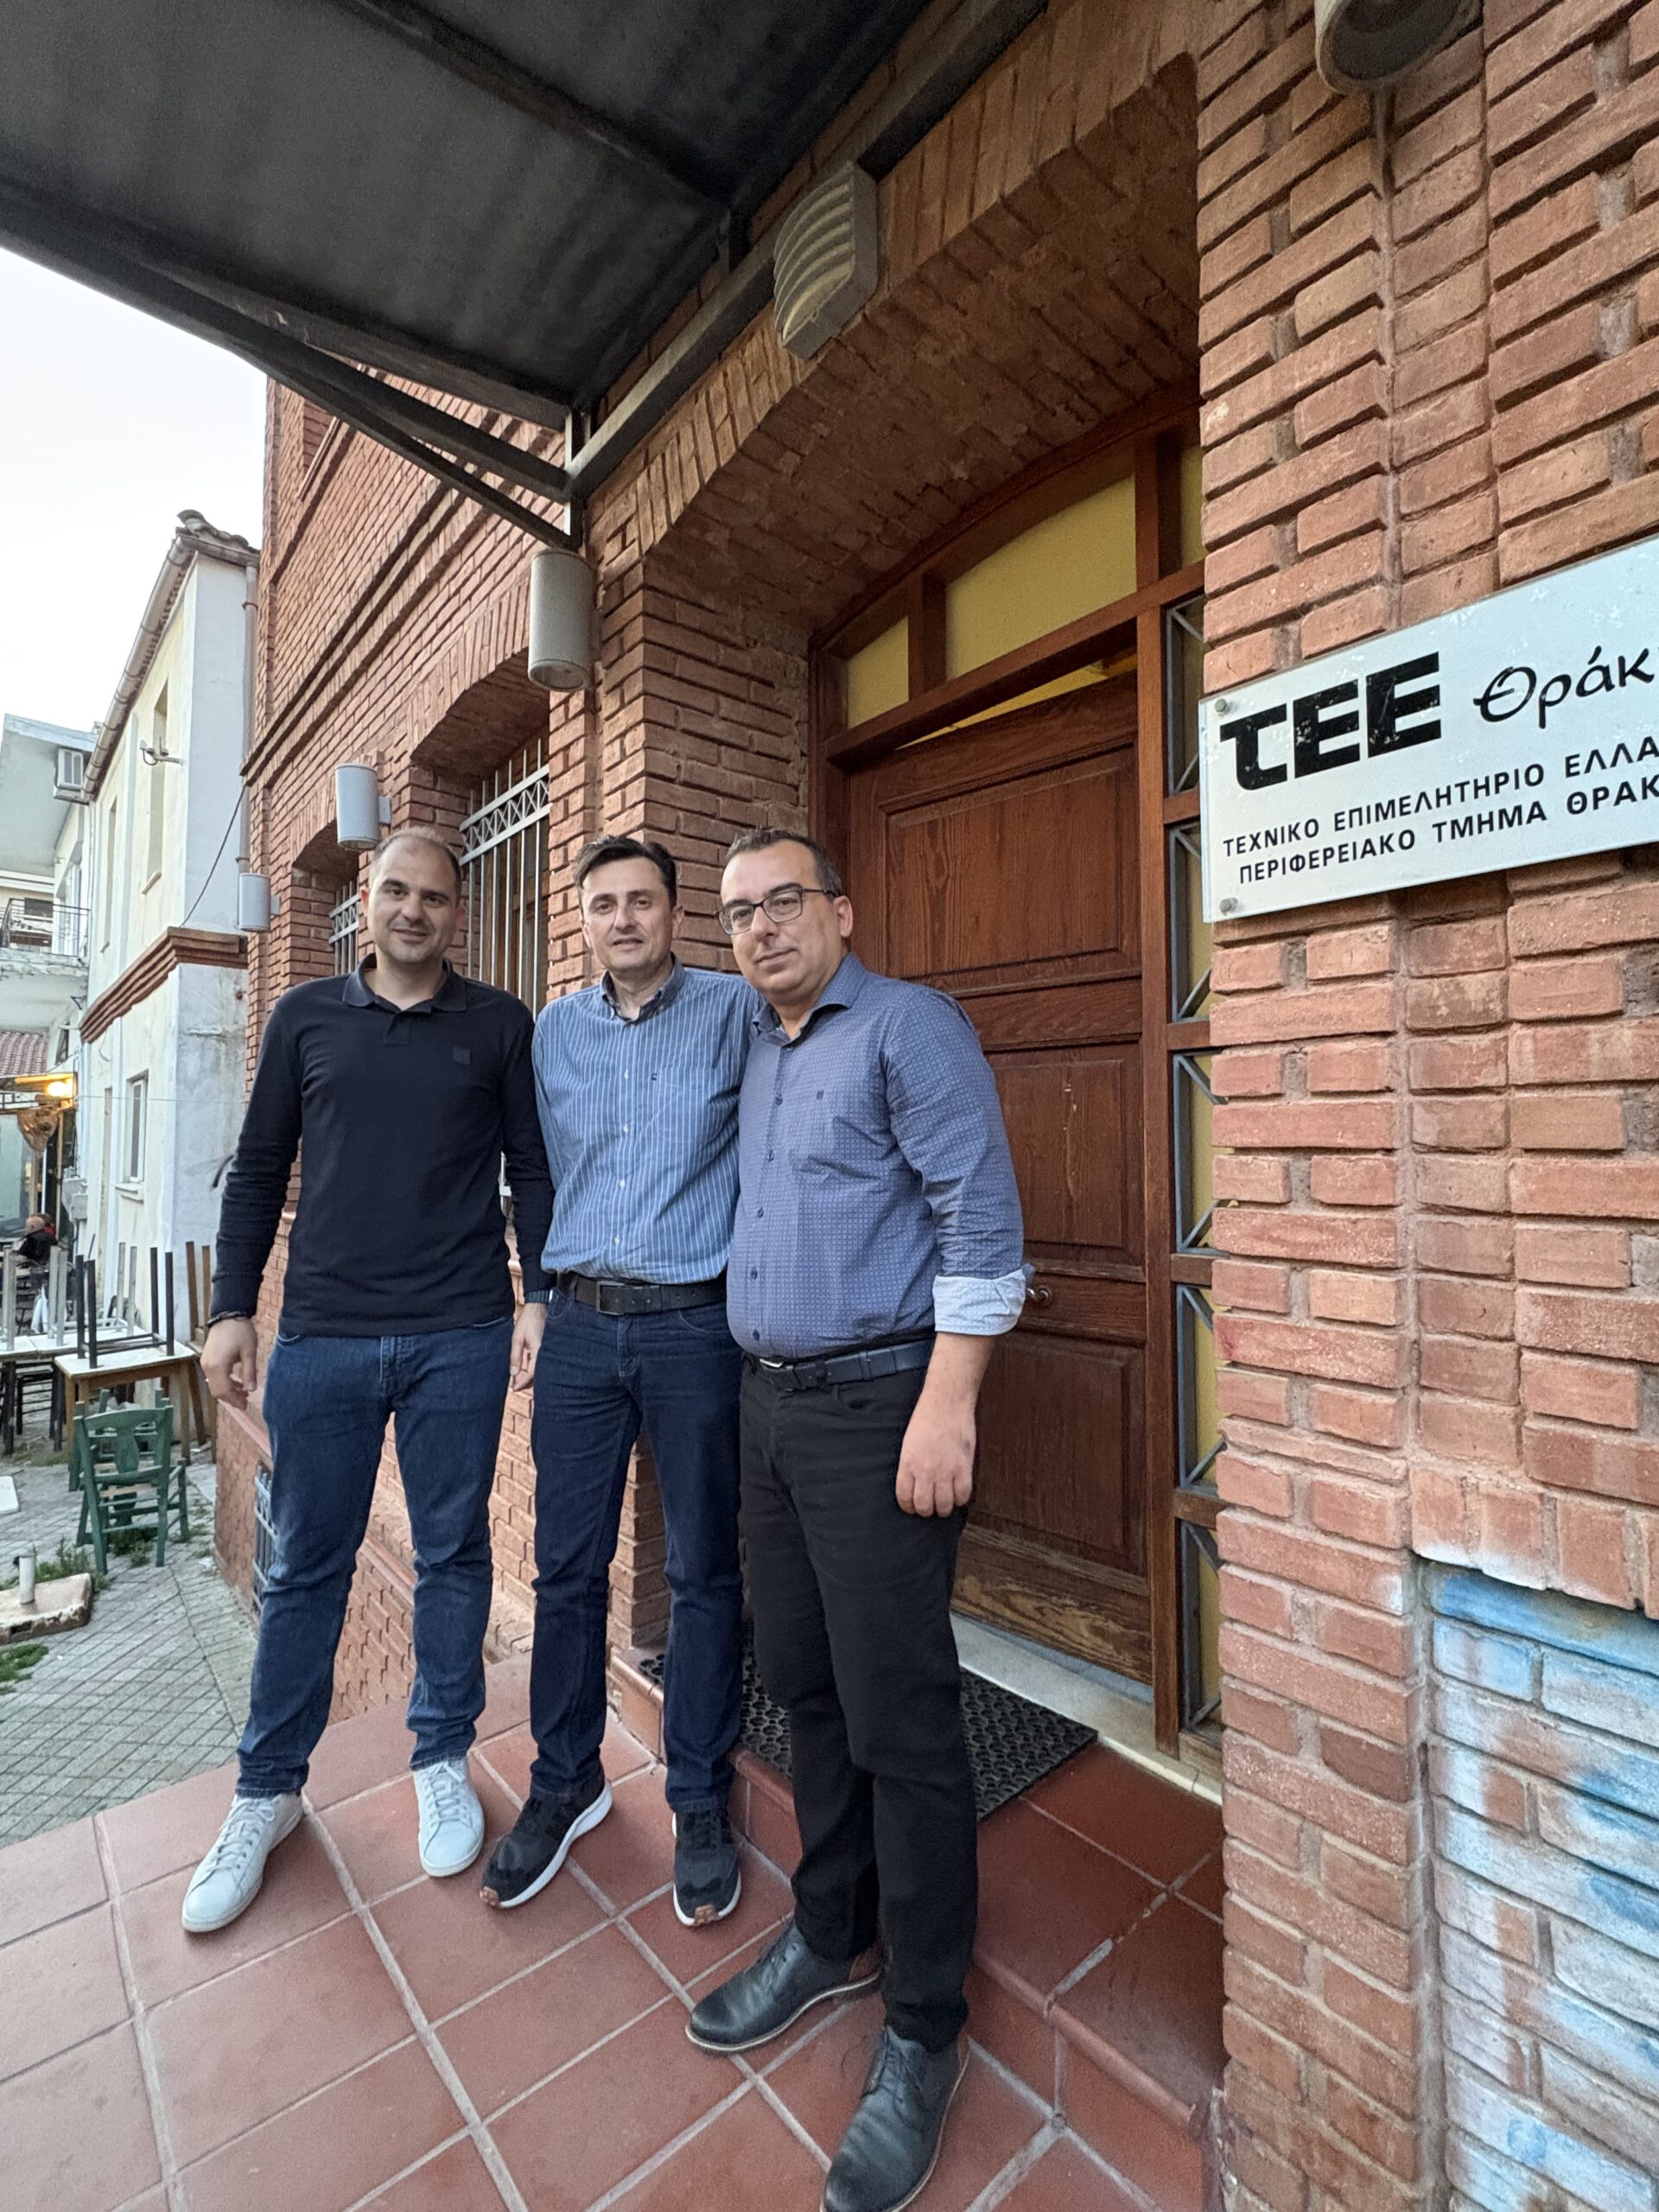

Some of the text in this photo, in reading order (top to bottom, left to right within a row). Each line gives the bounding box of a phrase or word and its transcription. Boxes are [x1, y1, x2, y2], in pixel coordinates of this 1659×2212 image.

[1473, 645, 1659, 728] Θράκ
[1224, 818, 1319, 857] ΤΕΧΝΙΚΟ
[1334, 763, 1545, 832] ΕΠΙΜΕΛΗΤΗΡΙΟ
[1240, 830, 1415, 883] ΠΕΡΙΦΕΡΕΙΑΚΟ
[1432, 801, 1547, 843] ΤΜΗΜΑ
